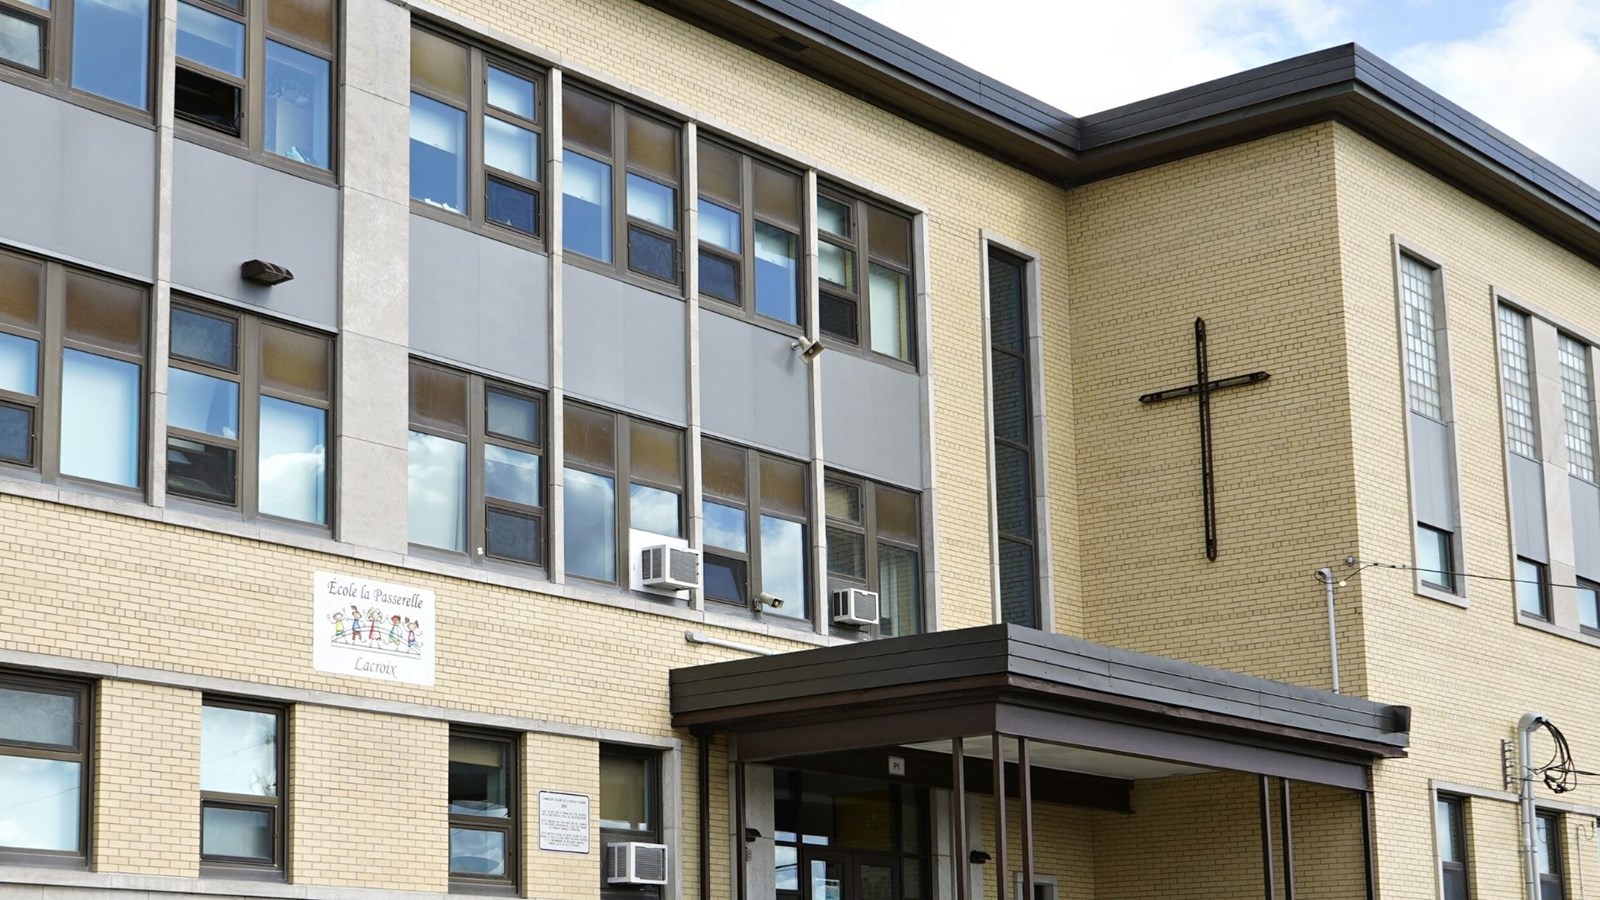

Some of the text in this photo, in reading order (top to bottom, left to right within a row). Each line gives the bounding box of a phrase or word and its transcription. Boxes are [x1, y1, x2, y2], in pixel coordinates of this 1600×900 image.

[327, 578, 423, 609] École la Passerelle
[354, 657, 397, 678] Lacroix
